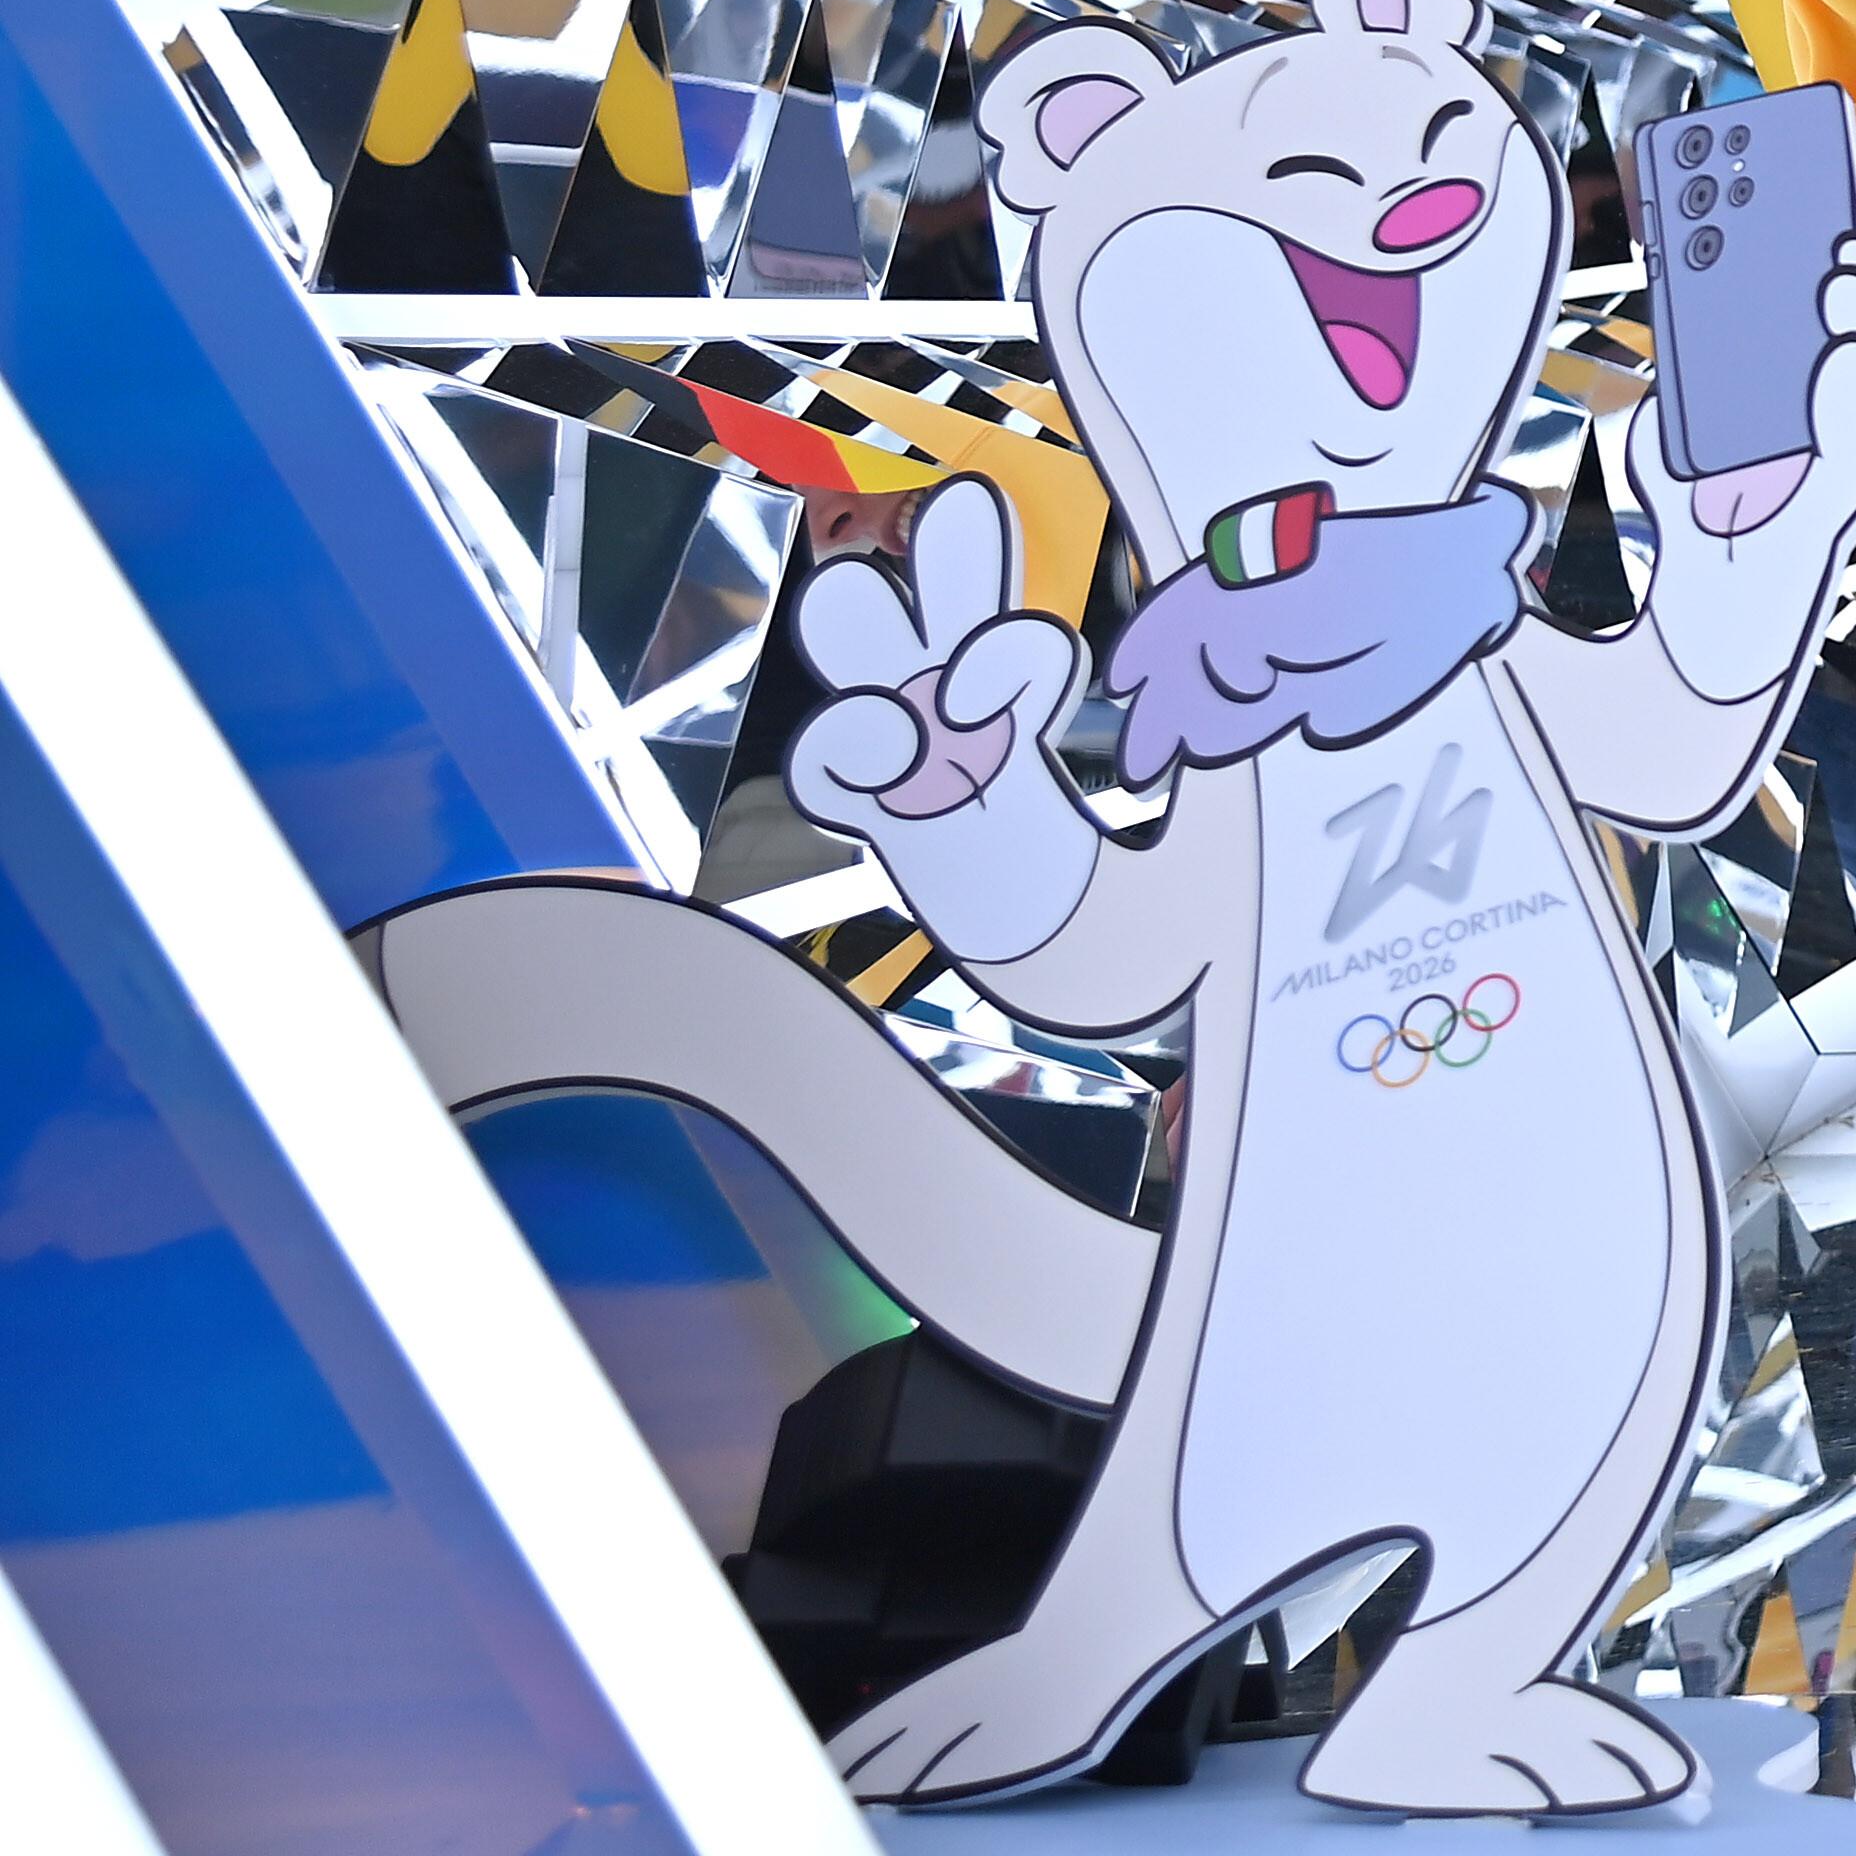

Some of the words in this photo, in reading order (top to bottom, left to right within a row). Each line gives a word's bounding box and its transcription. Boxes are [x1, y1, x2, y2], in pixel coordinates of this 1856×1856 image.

[1271, 936, 1413, 1002] MILANO
[1420, 889, 1569, 951] CORTINA
[1387, 952, 1457, 993] 2026
